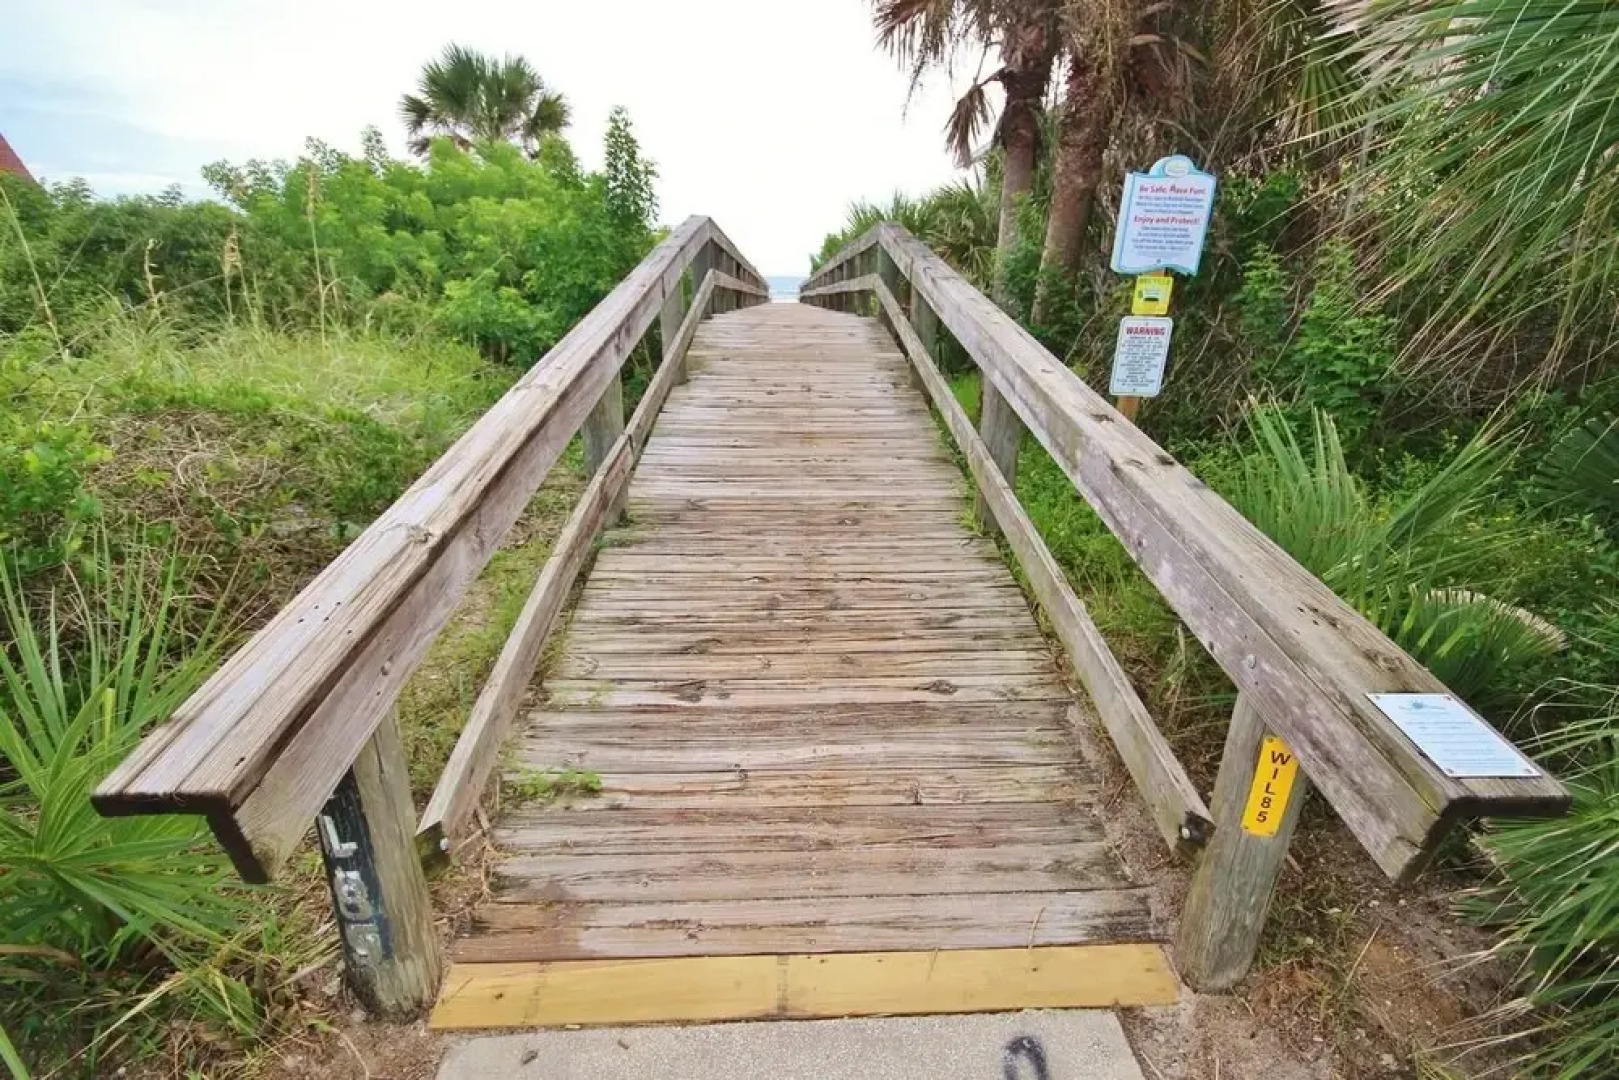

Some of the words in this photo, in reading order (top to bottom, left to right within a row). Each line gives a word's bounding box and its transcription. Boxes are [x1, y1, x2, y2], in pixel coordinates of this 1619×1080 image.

[1134, 215, 1153, 224] Enjoy
[1126, 326, 1166, 336] WARNING
[1256, 751, 1291, 823] WIL85
